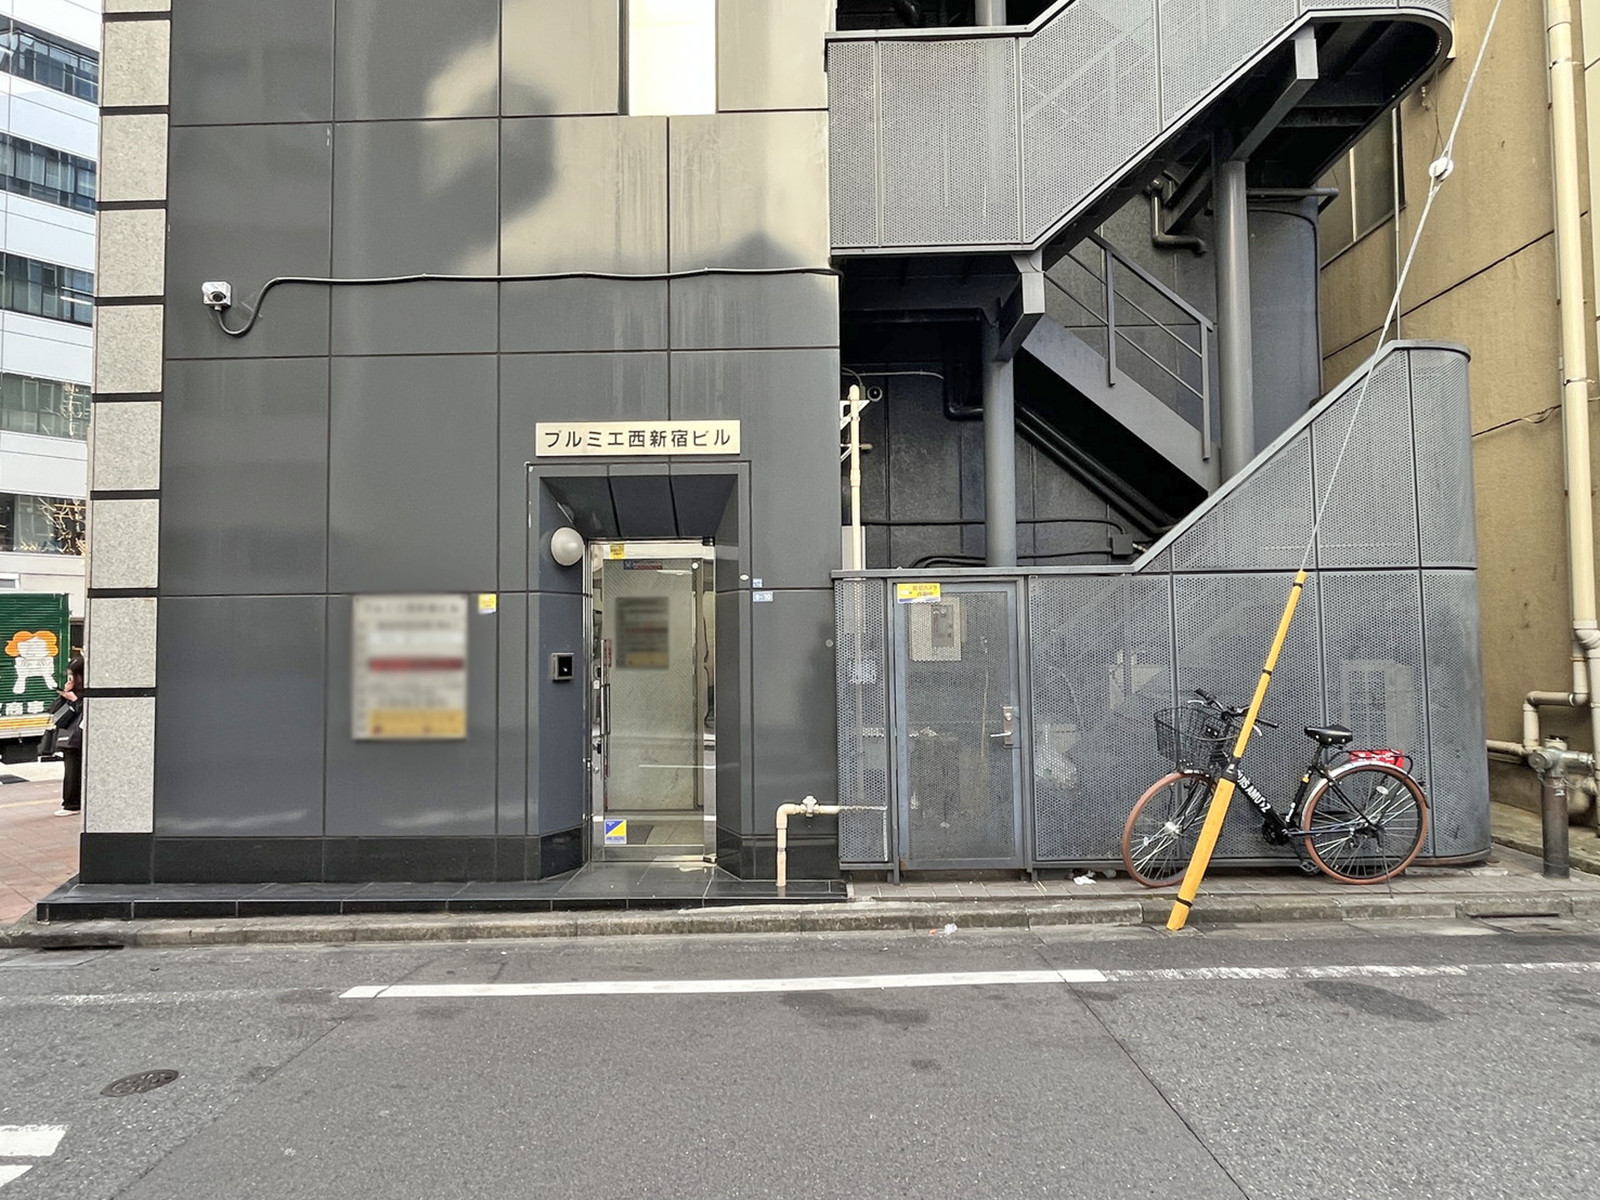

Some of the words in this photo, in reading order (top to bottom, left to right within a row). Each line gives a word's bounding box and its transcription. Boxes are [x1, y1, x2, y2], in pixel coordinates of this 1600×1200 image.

[544, 429, 730, 448] プルミエ西新宿ビル
